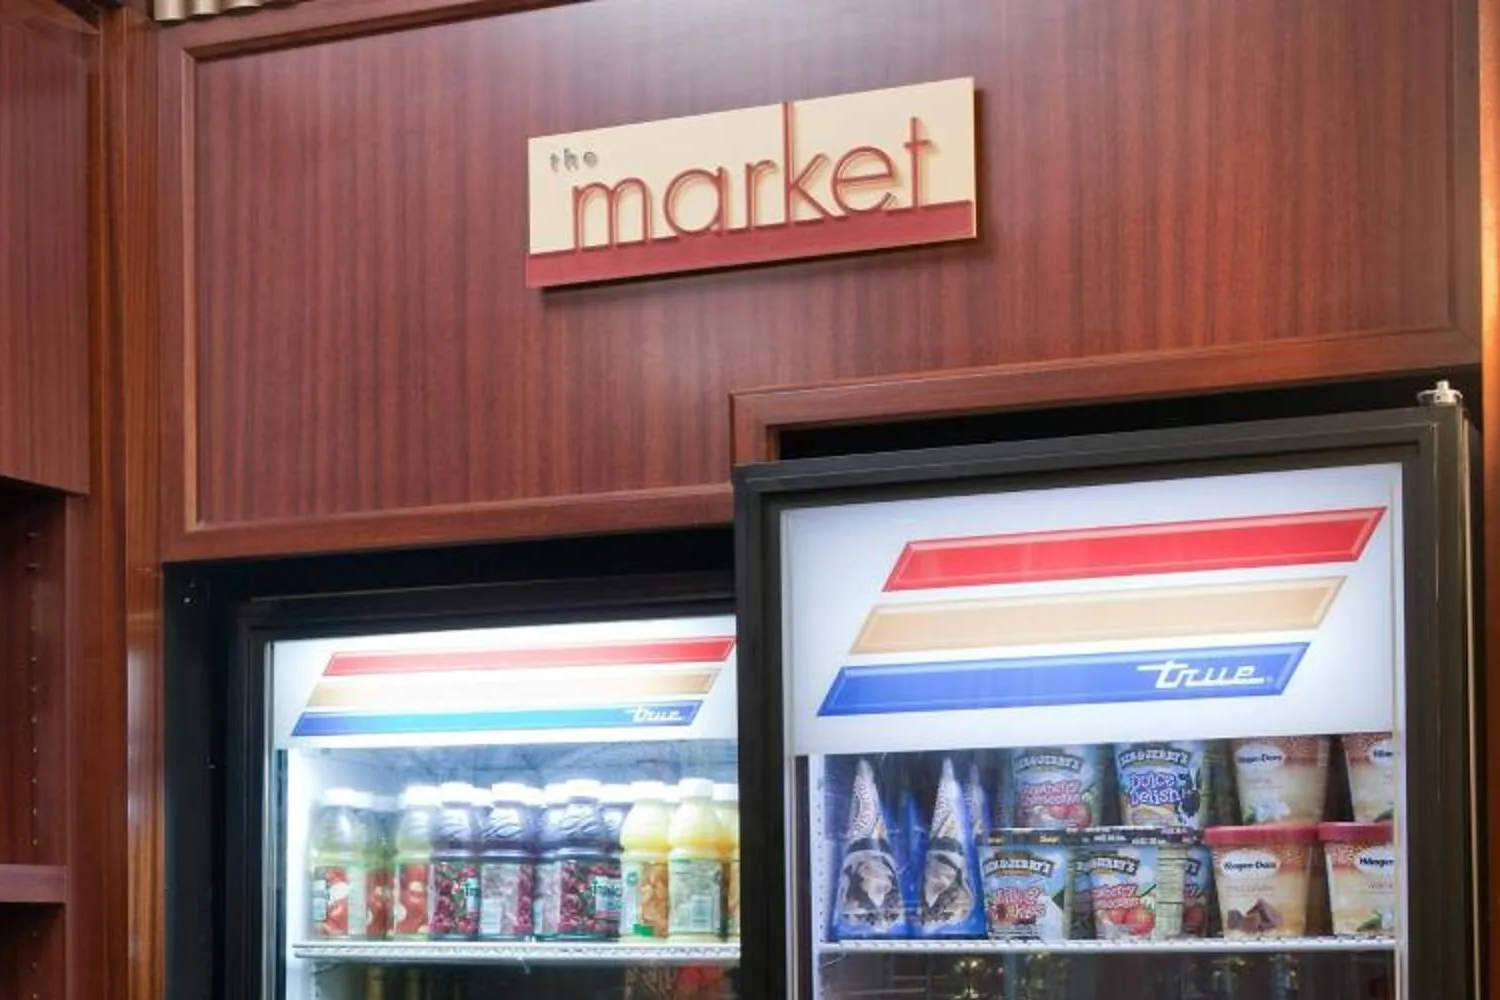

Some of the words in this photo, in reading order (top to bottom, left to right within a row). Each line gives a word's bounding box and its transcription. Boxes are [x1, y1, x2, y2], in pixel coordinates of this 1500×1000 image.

[550, 147, 598, 173] the
[573, 101, 934, 252] market
[1136, 660, 1265, 690] true
[623, 704, 683, 723] true
